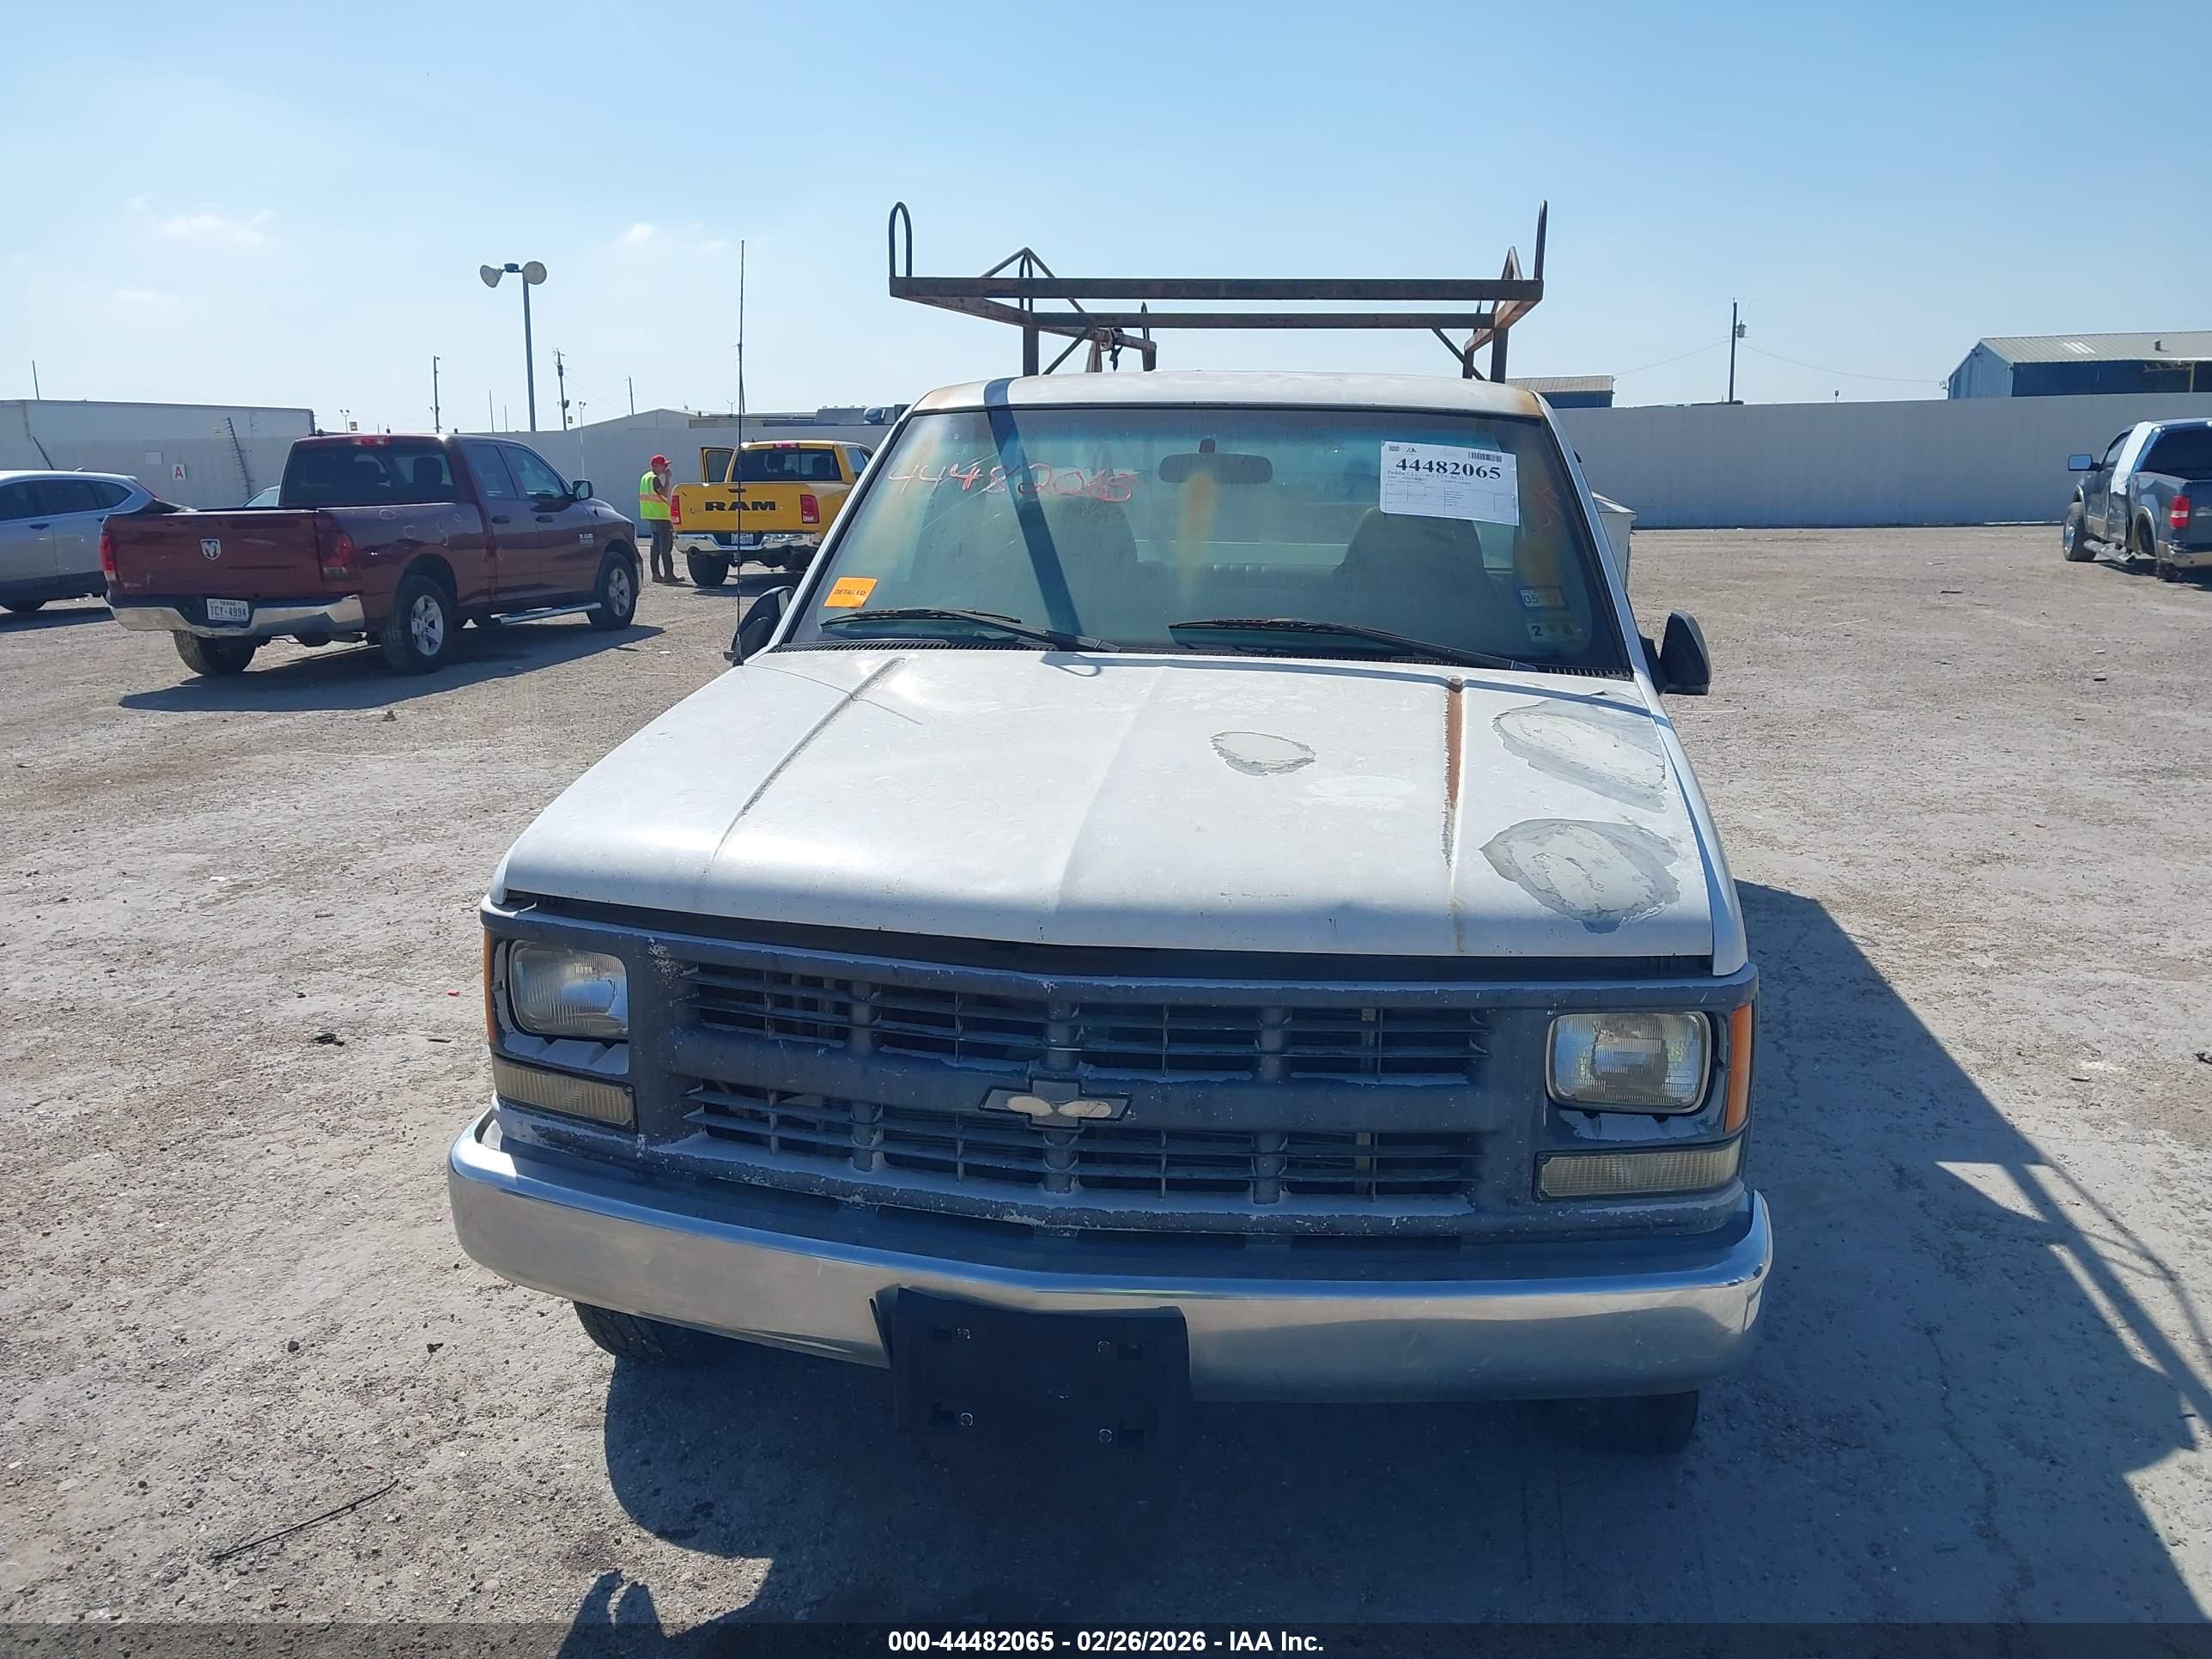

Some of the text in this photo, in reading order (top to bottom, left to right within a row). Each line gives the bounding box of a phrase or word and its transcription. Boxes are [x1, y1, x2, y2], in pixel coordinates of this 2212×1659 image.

[174, 465, 184, 478] A
[1395, 458, 1502, 480] 44482065
[705, 501, 776, 512] RAM
